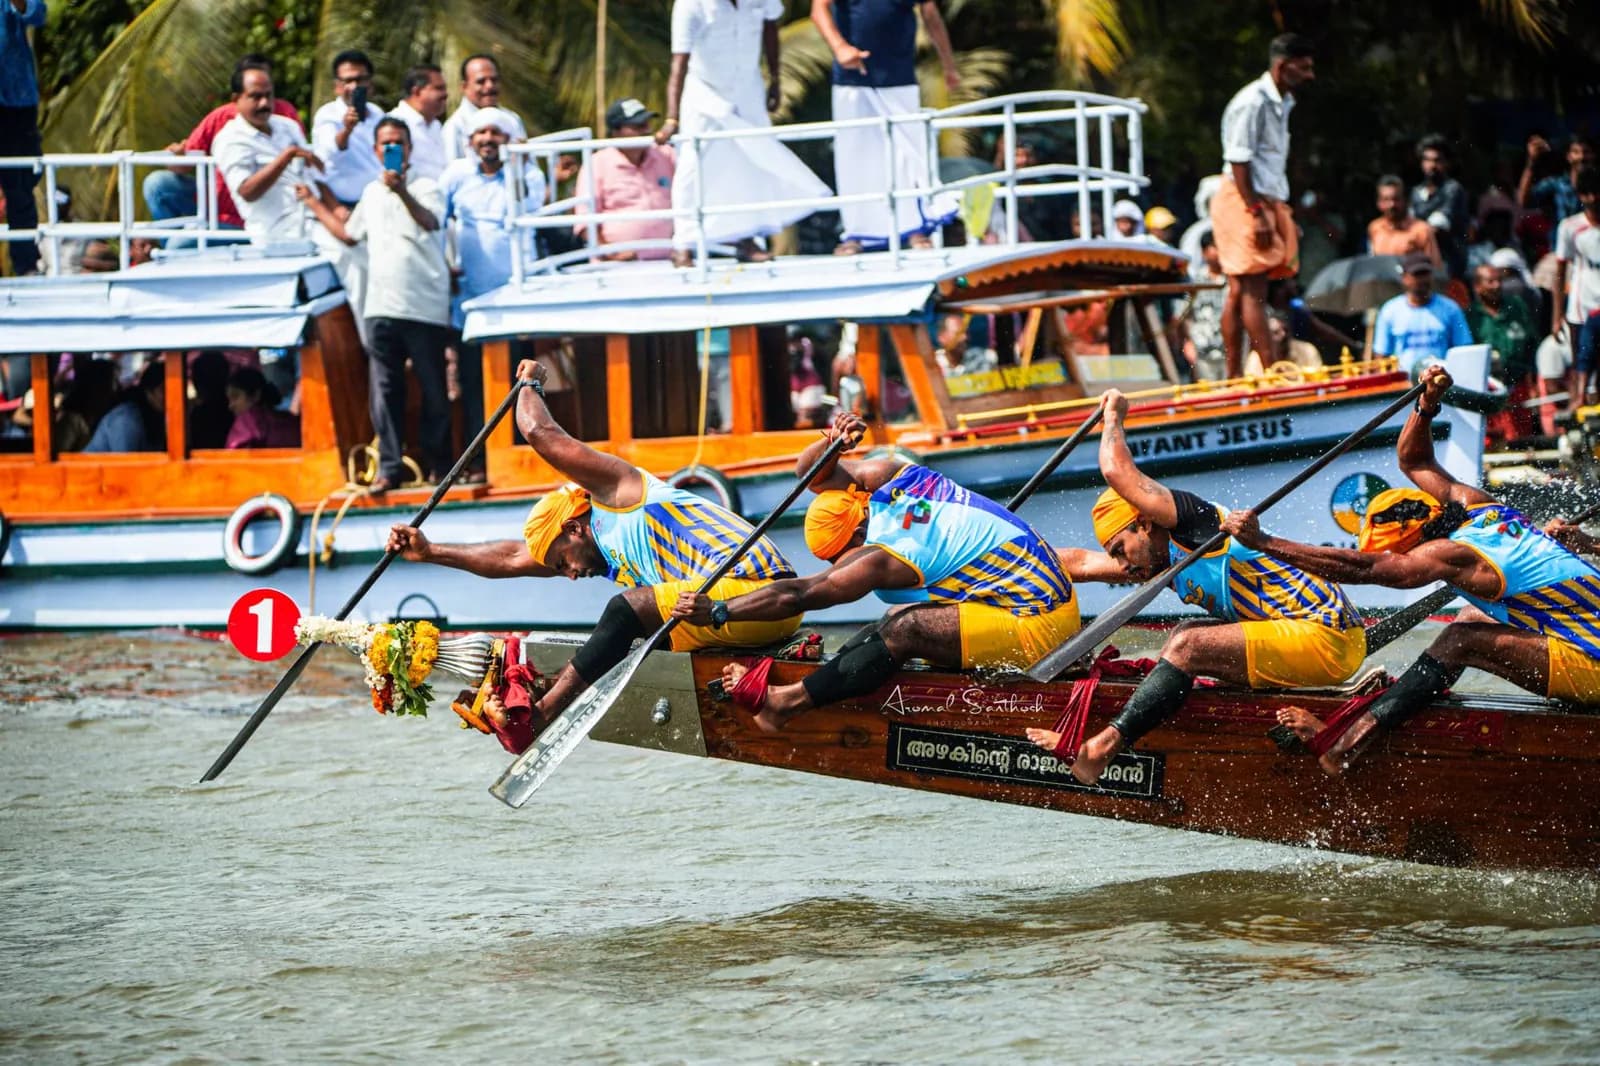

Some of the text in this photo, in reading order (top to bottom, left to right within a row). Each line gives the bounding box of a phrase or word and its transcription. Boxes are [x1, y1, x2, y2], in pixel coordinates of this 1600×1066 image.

[1126, 418, 1293, 457] NFANT JESUS
[248, 598, 274, 653] 1
